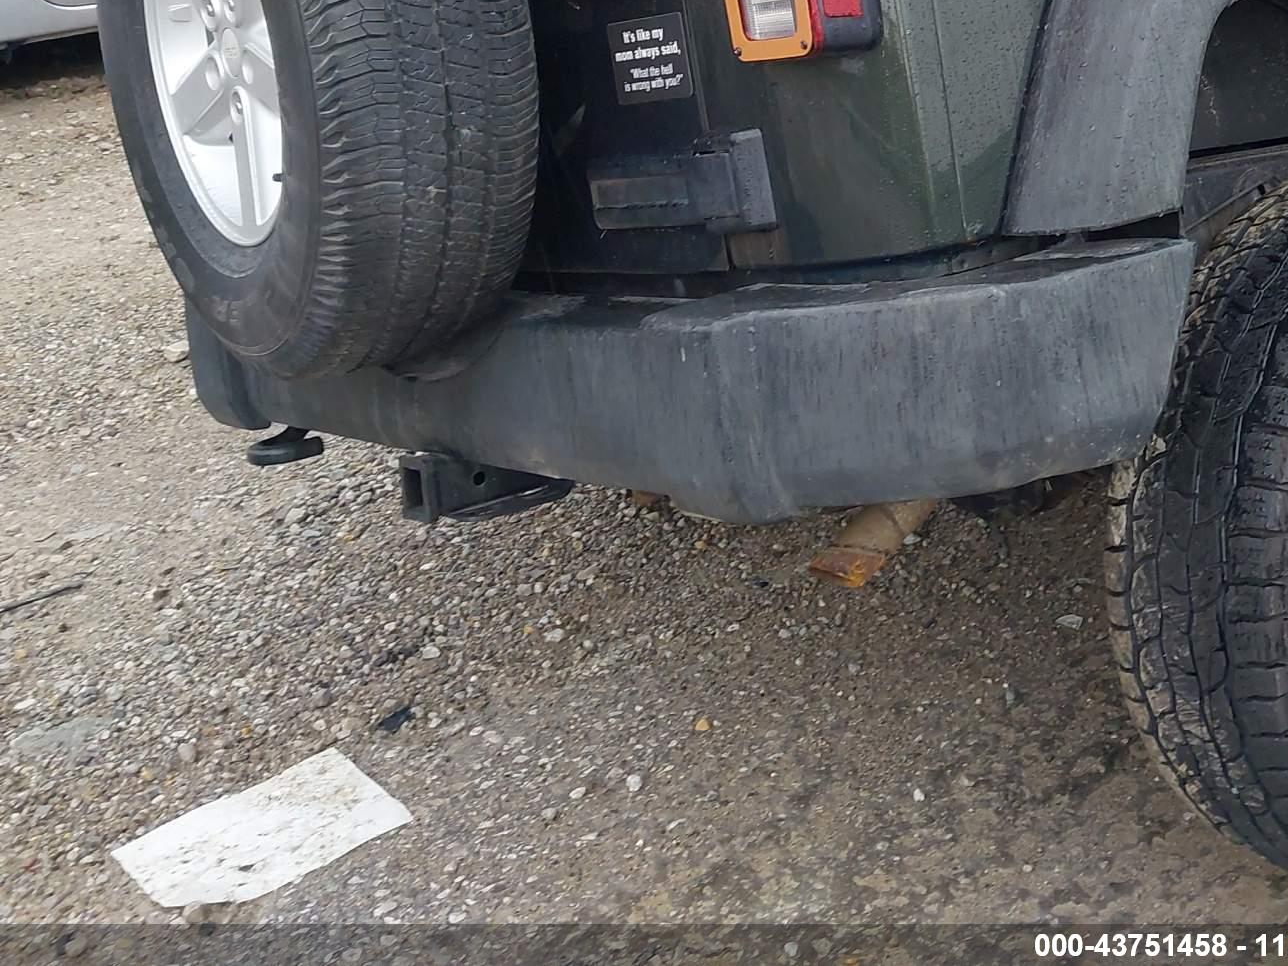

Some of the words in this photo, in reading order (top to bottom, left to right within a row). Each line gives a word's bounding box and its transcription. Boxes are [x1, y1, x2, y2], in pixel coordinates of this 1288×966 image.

[622, 31, 636, 44] It's
[636, 28, 650, 41] like
[651, 28, 664, 41] my
[615, 51, 634, 62] mom
[634, 47, 660, 59] always
[661, 41, 681, 55] said,
[630, 67, 649, 78] "What
[649, 66, 660, 77] the
[661, 63, 673, 75] hell
[624, 81, 631, 92] is
[631, 81, 650, 92] wrong
[651, 77, 664, 88] with
[665, 74, 683, 90] you?"
